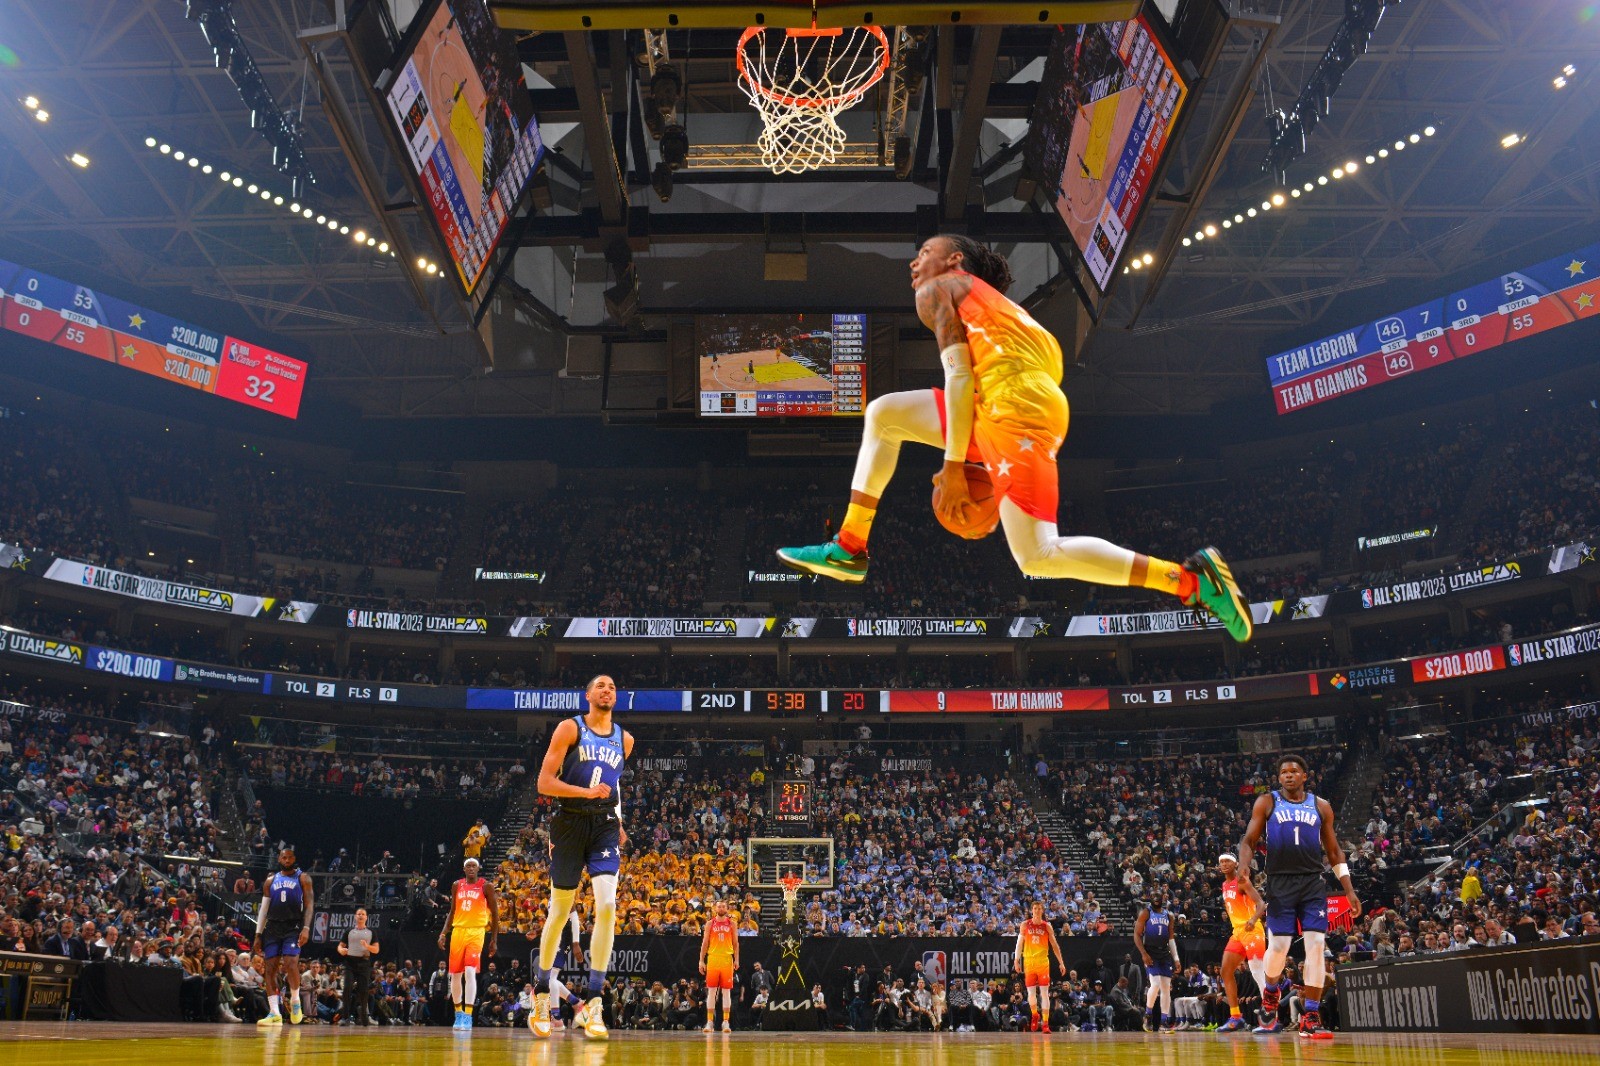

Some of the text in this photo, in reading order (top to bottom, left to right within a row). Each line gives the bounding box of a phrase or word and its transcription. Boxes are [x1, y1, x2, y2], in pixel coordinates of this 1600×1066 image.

[27, 278, 39, 292] 0
[1504, 280, 1525, 296] 53
[20, 296, 38, 309] 3RD
[73, 293, 94, 310] 53
[1457, 298, 1467, 312] 0
[1505, 297, 1532, 312] TOTAL
[18, 313, 30, 326] 0
[67, 311, 92, 326] TOTAL
[1420, 311, 1430, 325] 7
[1458, 316, 1475, 328] 3RD
[1513, 314, 1534, 331] 55
[65, 327, 85, 344] 55
[1381, 321, 1400, 338] 46
[1421, 328, 1438, 341] 2ND
[171, 325, 219, 354] $200,000
[1465, 333, 1476, 347] 0
[175, 346, 208, 363] CHARITY
[1428, 344, 1439, 358] 9
[1276, 349, 1310, 378] TEAM
[1389, 356, 1408, 371] 46
[164, 359, 211, 386] $200,000
[244, 375, 275, 403] 32
[1280, 365, 1368, 410] TEAM GIANNIS
[139, 579, 165, 599] 2023
[166, 584, 199, 602] UTAH
[1420, 577, 1446, 598] 2023
[1449, 570, 1483, 589] UTAH
[400, 614, 423, 632] 2023
[426, 617, 456, 631] UTAH
[650, 619, 672, 636] 2023
[675, 620, 704, 633] UTAH
[900, 619, 922, 636] 2023
[925, 619, 955, 633] UTAH
[1152, 613, 1175, 631] 2023
[9, 634, 46, 654] UTAH
[96, 650, 161, 680] $200,000
[1425, 649, 1493, 679] $200,000
[188, 667, 200, 678] Big
[200, 669, 226, 680] Brothers
[226, 673, 237, 684] Big
[237, 674, 259, 684] Sisters
[1349, 667, 1395, 679] RAISE the
[1349, 674, 1396, 688] FUTURE
[286, 681, 329, 696] TOL 2
[348, 687, 392, 700] FLS 0
[1185, 687, 1230, 700] FLS 0
[514, 691, 541, 709] TEAM
[627, 691, 635, 710] 7
[700, 694, 736, 708] 2ND
[767, 692, 805, 709] 9:38
[843, 693, 864, 710] 20
[937, 691, 945, 711] 9
[991, 692, 1063, 710] TEAM GIANNIS
[1122, 691, 1167, 704] TOL 2
[779, 794, 803, 813] 20
[1293, 826, 1300, 846] 1
[280, 890, 287, 903] 6
[460, 900, 472, 912] 43
[367, 913, 380, 928] 023
[1157, 925, 1163, 936] 1
[618, 950, 649, 973] 2023
[1345, 972, 1390, 988] BUILT BY
[33, 991, 62, 1005] SUNDAY
[1466, 970, 1499, 1021] NBA
[1495, 966, 1592, 1021] Celebrates
[1347, 985, 1439, 1028] BLACK HISTORY
